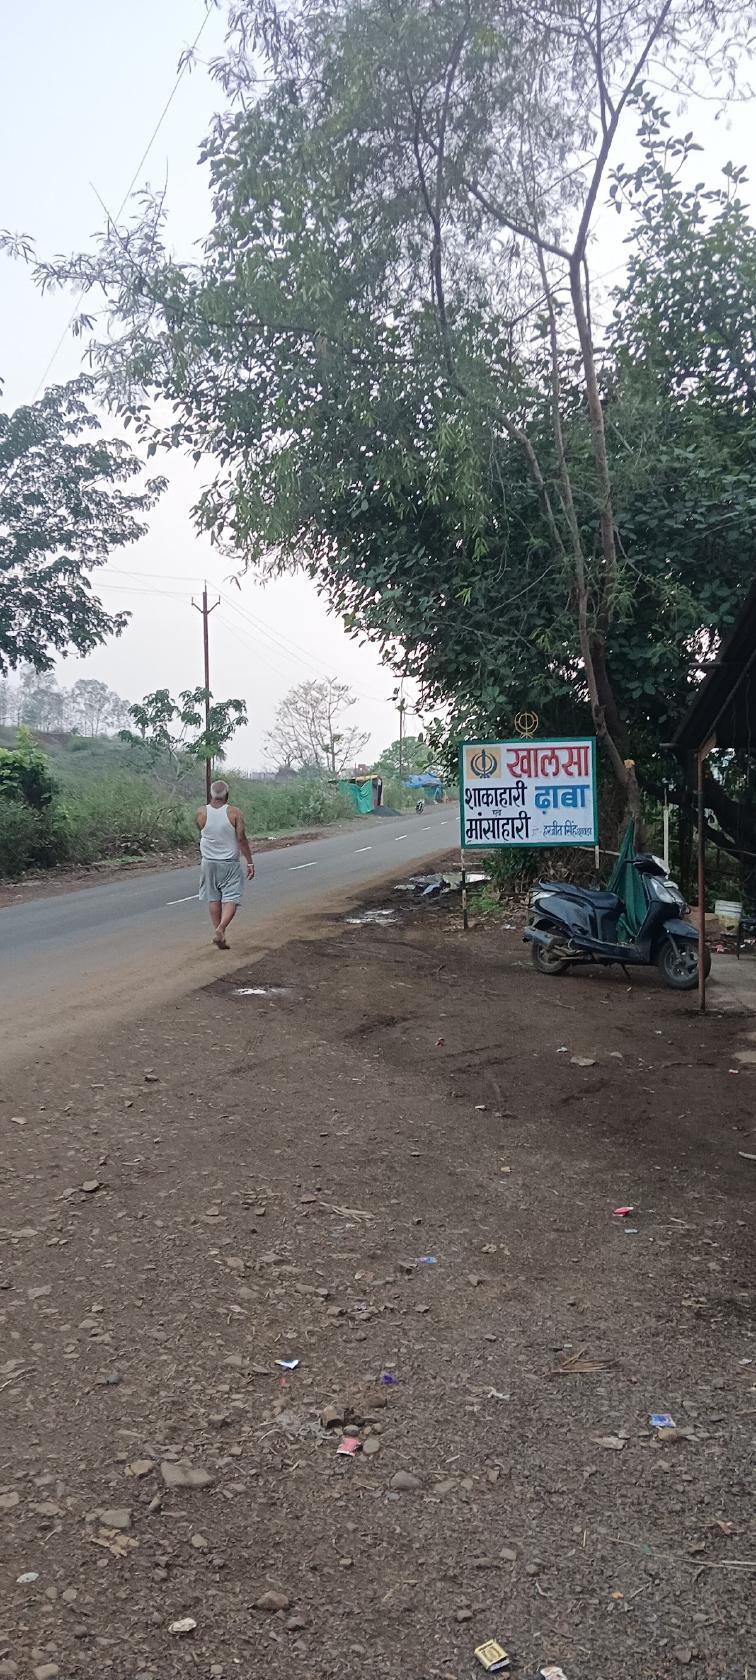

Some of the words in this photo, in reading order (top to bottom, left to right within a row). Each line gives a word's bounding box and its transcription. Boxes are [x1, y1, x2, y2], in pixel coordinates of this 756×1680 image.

[506, 746, 589, 778] खालसा
[465, 780, 527, 810] शाकाहारी
[466, 811, 531, 841] मांसाहारी
